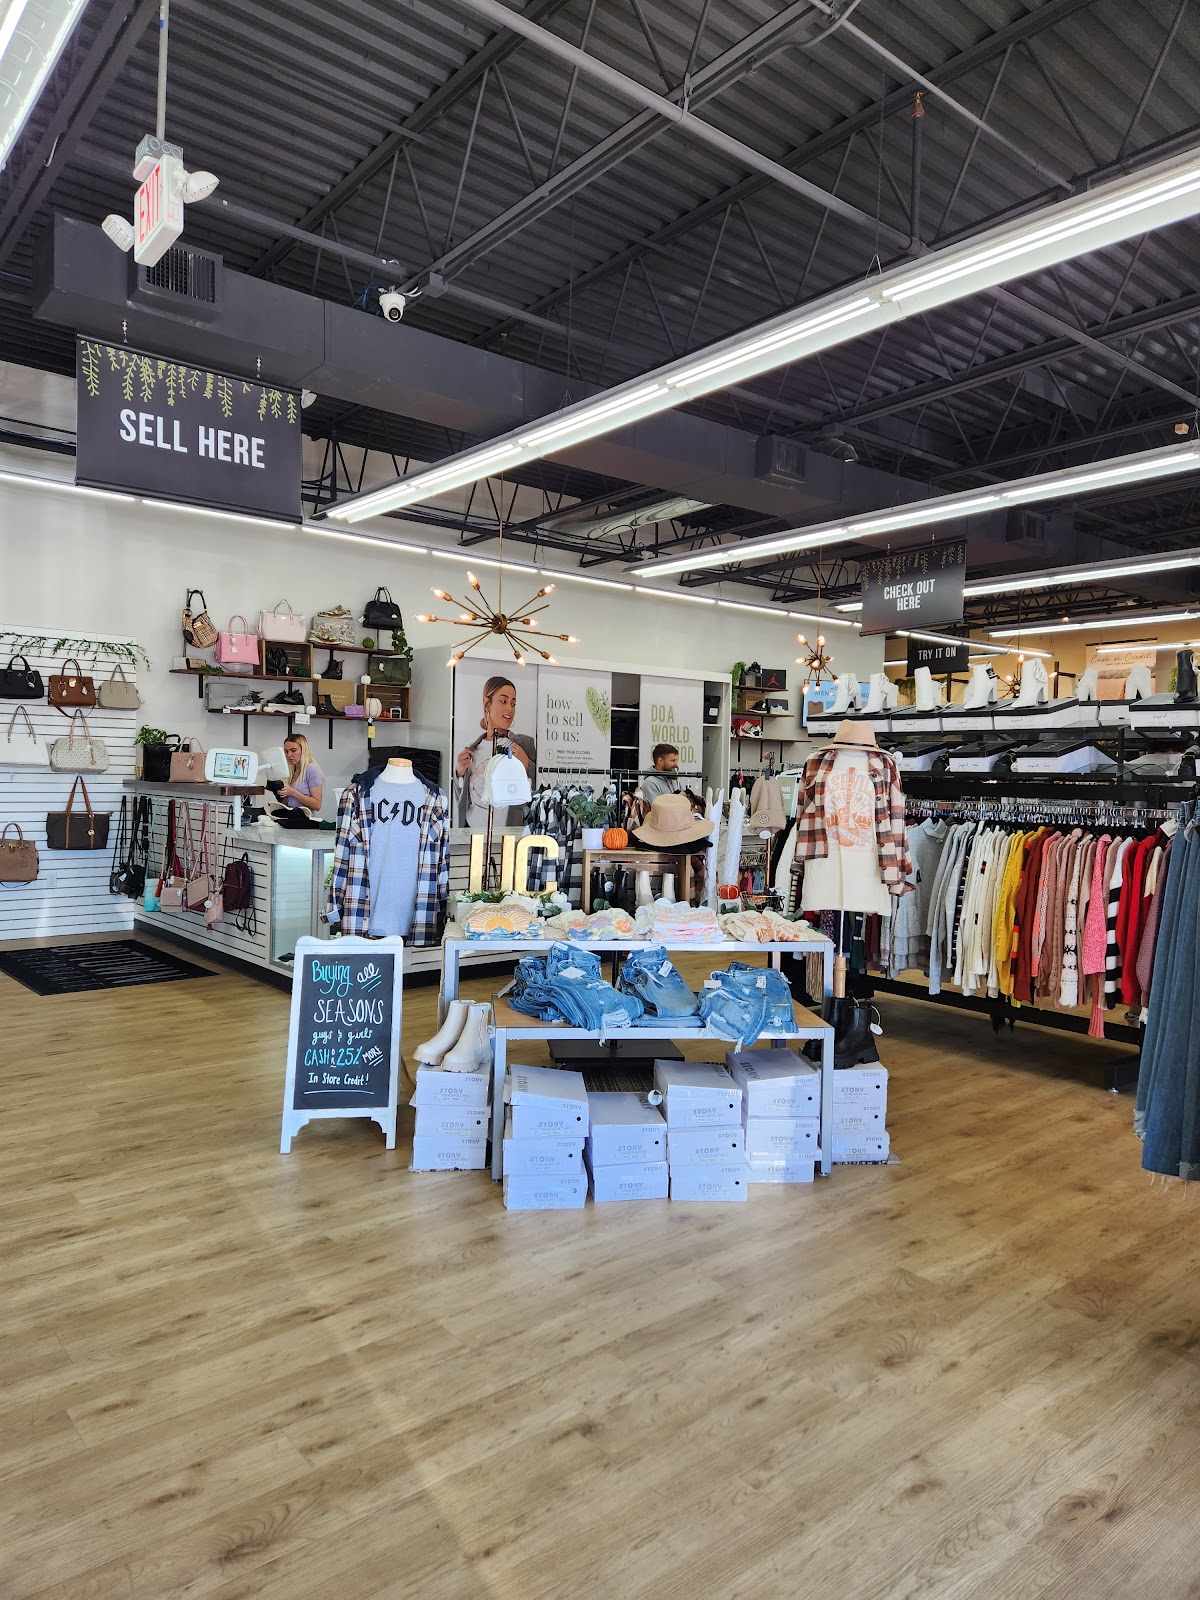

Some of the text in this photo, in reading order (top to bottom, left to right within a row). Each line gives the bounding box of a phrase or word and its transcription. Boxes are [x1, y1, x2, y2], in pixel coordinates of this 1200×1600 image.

[140, 164, 160, 244] EXIT
[120, 408, 265, 468] SELL HERE
[884, 579, 936, 600] CHECK OUT
[897, 595, 920, 611] HERE
[918, 646, 956, 660] TRY IT ON
[1090, 655, 1110, 664] Cash
[1125, 652, 1152, 661] Credit
[546, 694, 572, 710] how
[546, 712, 584, 727] to sell
[652, 704, 674, 723] DO A
[546, 729, 580, 742] to us:
[651, 724, 690, 744] WORLD
[469, 834, 560, 895] UC
[312, 960, 380, 998] Buying all
[314, 999, 384, 1026] SEASONS
[312, 1030, 333, 1045] guys
[348, 1027, 374, 1045] girls
[304, 1046, 382, 1066] CASH OR 25% MORE
[308, 1072, 369, 1086] In Store Credit!
